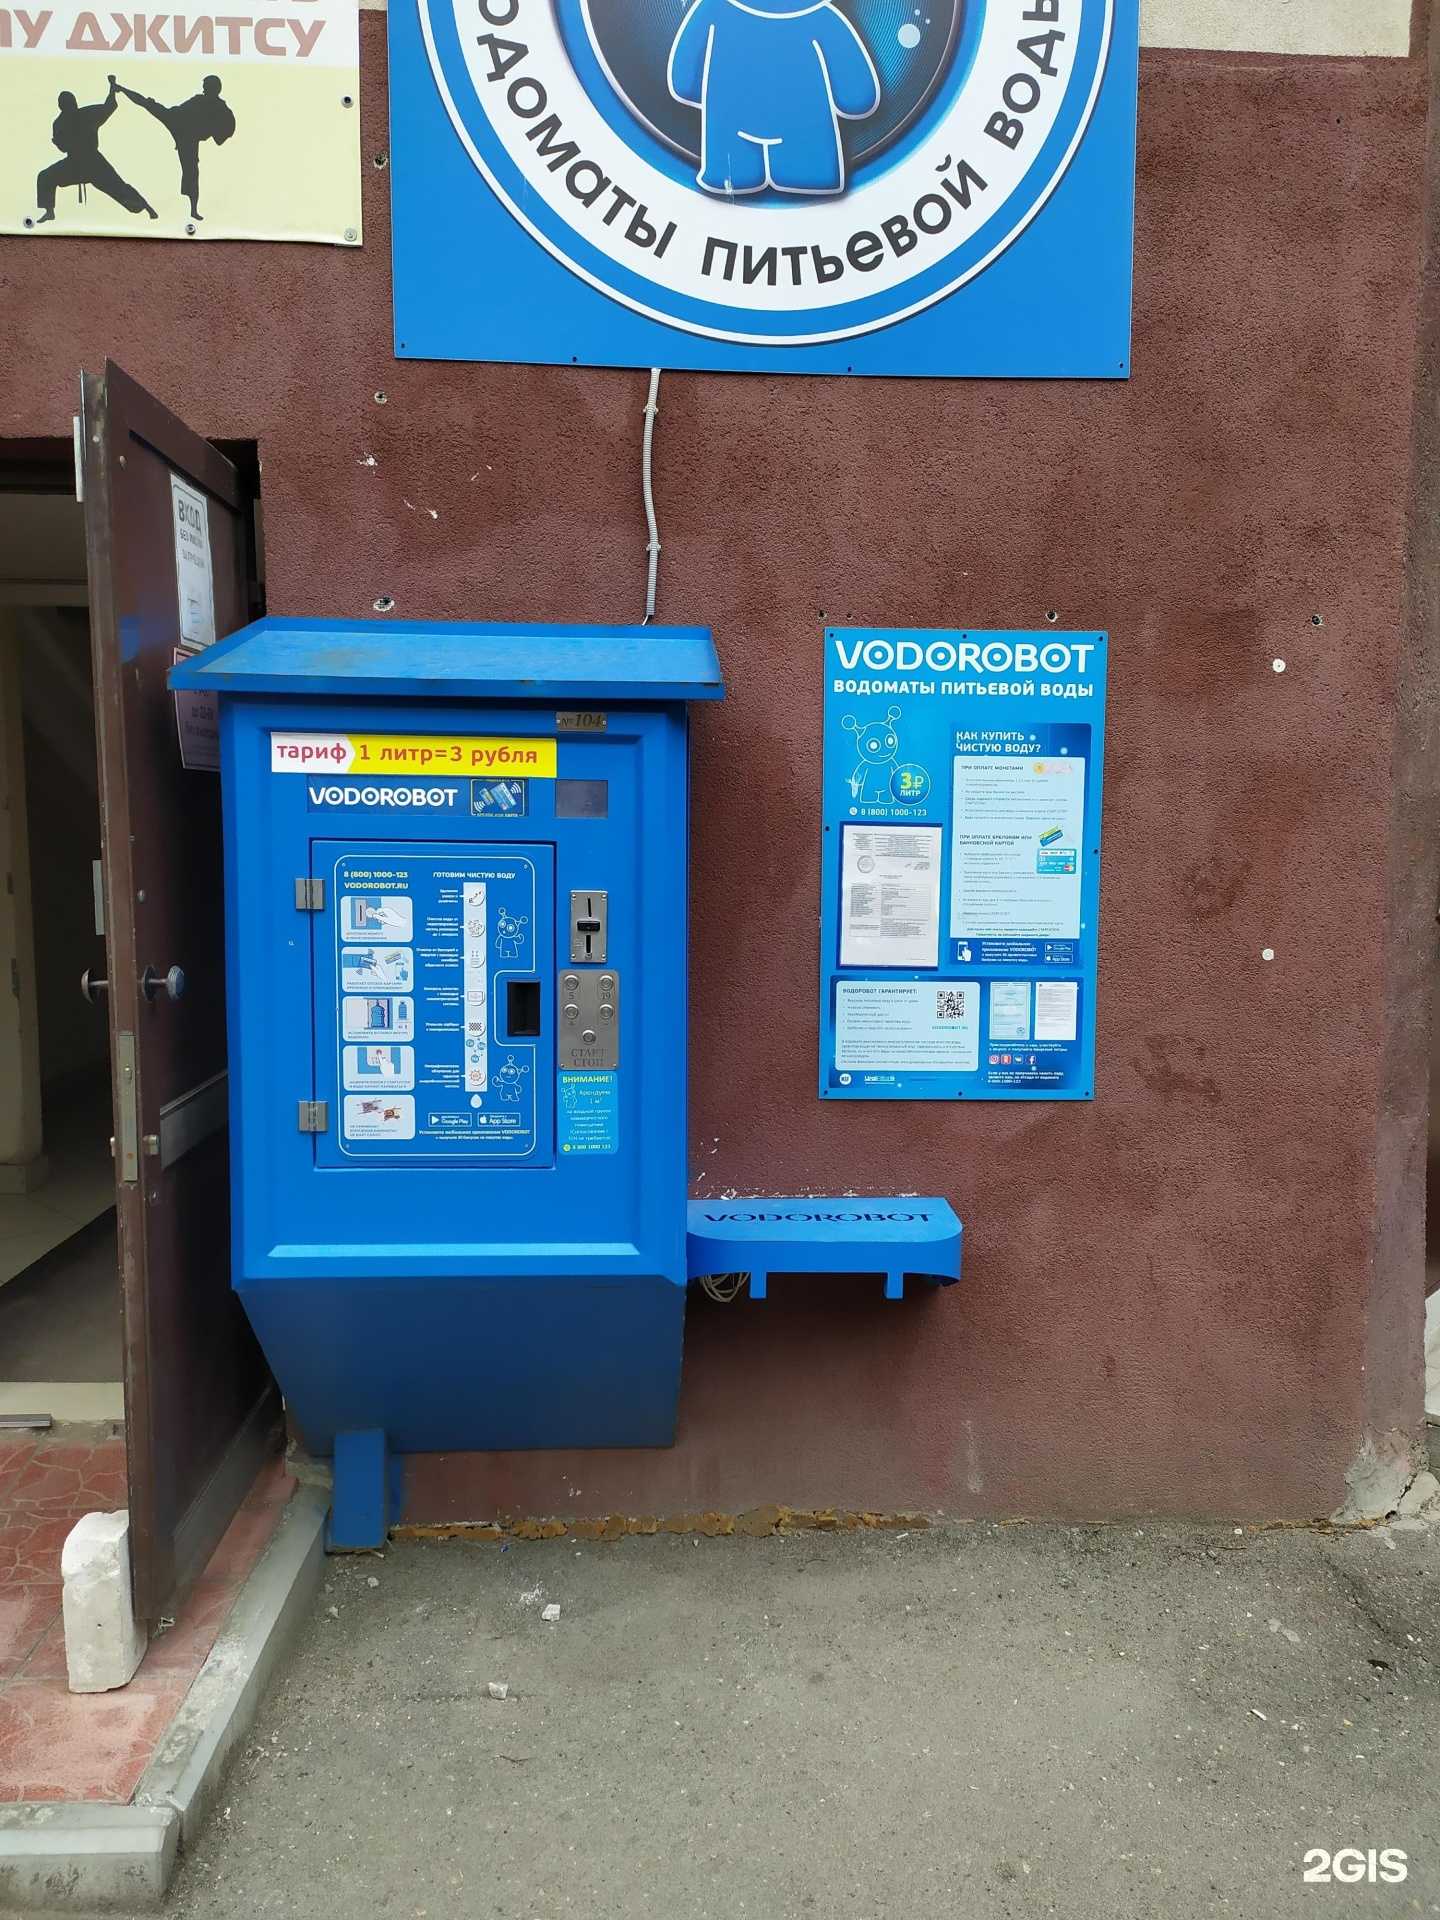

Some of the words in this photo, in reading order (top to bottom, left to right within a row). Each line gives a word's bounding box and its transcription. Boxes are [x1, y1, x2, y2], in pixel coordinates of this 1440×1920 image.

[66, 11, 327, 57] ДЖИТСУ
[178, 500, 202, 534] ВХОД
[835, 639, 1094, 674] VODOROBOT
[833, 680, 935, 696] ВОДОМАТЫ
[941, 680, 1034, 697] ПИТЬЕВОЙ
[1041, 683, 1094, 698] ВОДЫ
[956, 732, 978, 741] КАК
[981, 731, 1025, 741] КУПИТЬ
[276, 743, 347, 763] тариф
[359, 744, 371, 760] 1
[471, 746, 538, 766] рубля
[956, 743, 1002, 753] ЧИСТУЮ
[1005, 744, 1041, 754] ВОДУ?
[308, 786, 458, 807] VODOROBOT
[900, 789, 921, 797] ЛИТР
[860, 808, 866, 817] 8
[868, 808, 888, 817] (800)
[890, 808, 927, 817] 1000-123
[704, 1213, 932, 1222] VODOROBOT
